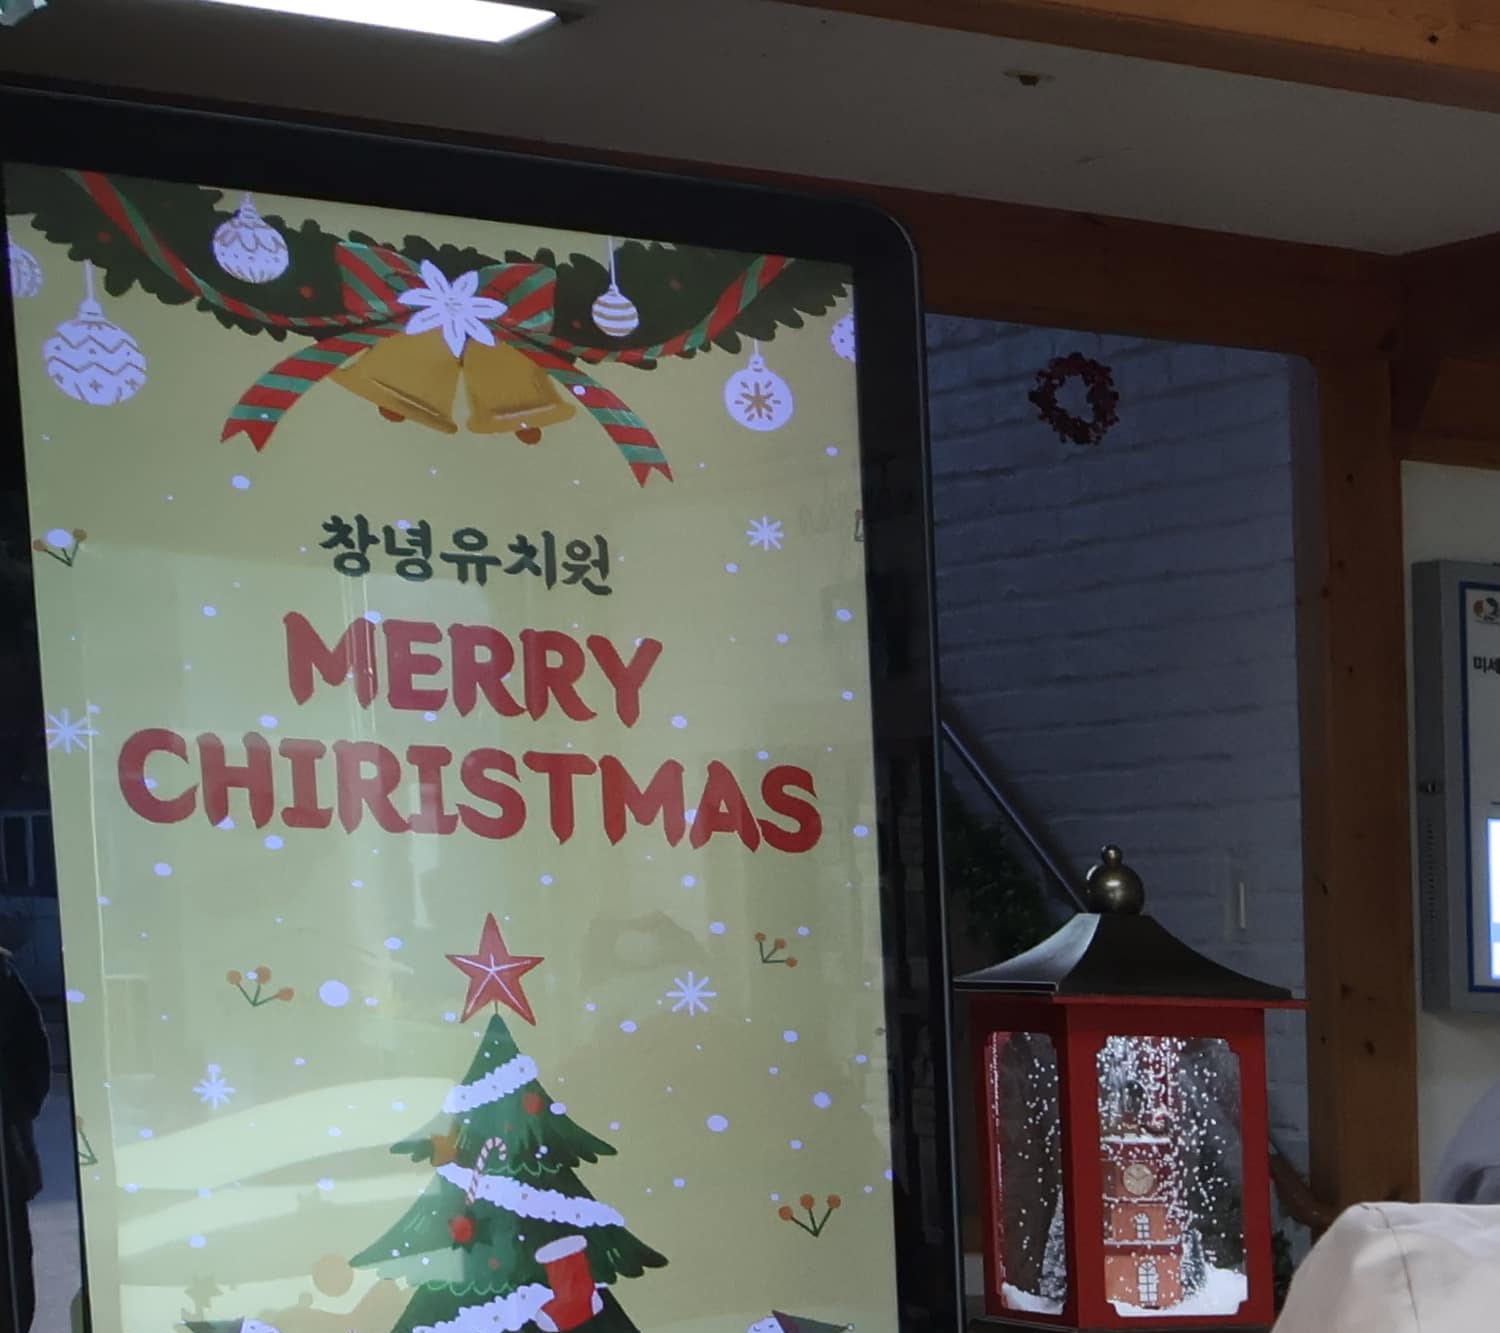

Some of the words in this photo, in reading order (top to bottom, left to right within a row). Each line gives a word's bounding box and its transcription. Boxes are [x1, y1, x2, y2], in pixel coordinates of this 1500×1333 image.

[319, 513, 613, 596] 창녕유치원
[282, 611, 663, 728] MERRY
[117, 728, 823, 854] CHIRISTMAS
